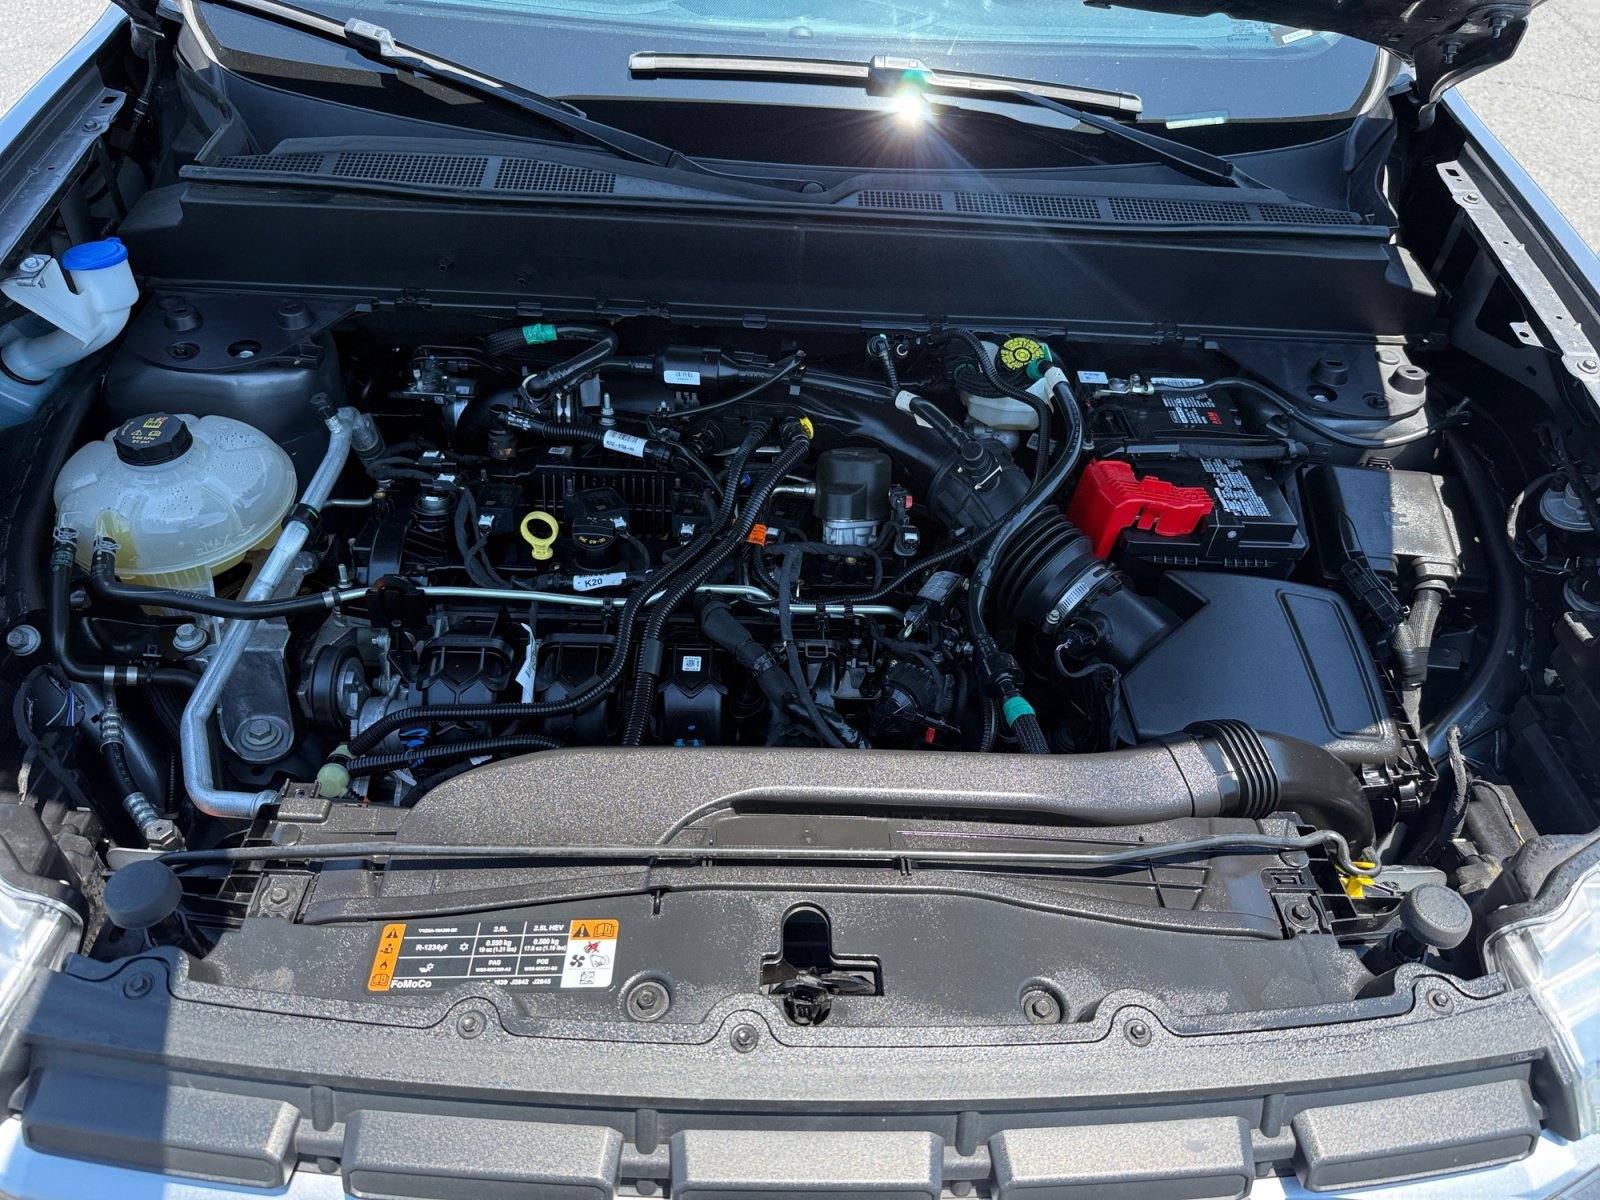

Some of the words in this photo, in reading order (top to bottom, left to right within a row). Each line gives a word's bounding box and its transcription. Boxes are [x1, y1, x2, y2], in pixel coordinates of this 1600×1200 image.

[584, 578, 603, 588] K20
[493, 925, 509, 933] 2.0L
[503, 939, 512, 947] kg
[551, 938, 560, 946] kg
[416, 943, 449, 952] R-1234yf
[391, 979, 432, 989] FoMoCo
